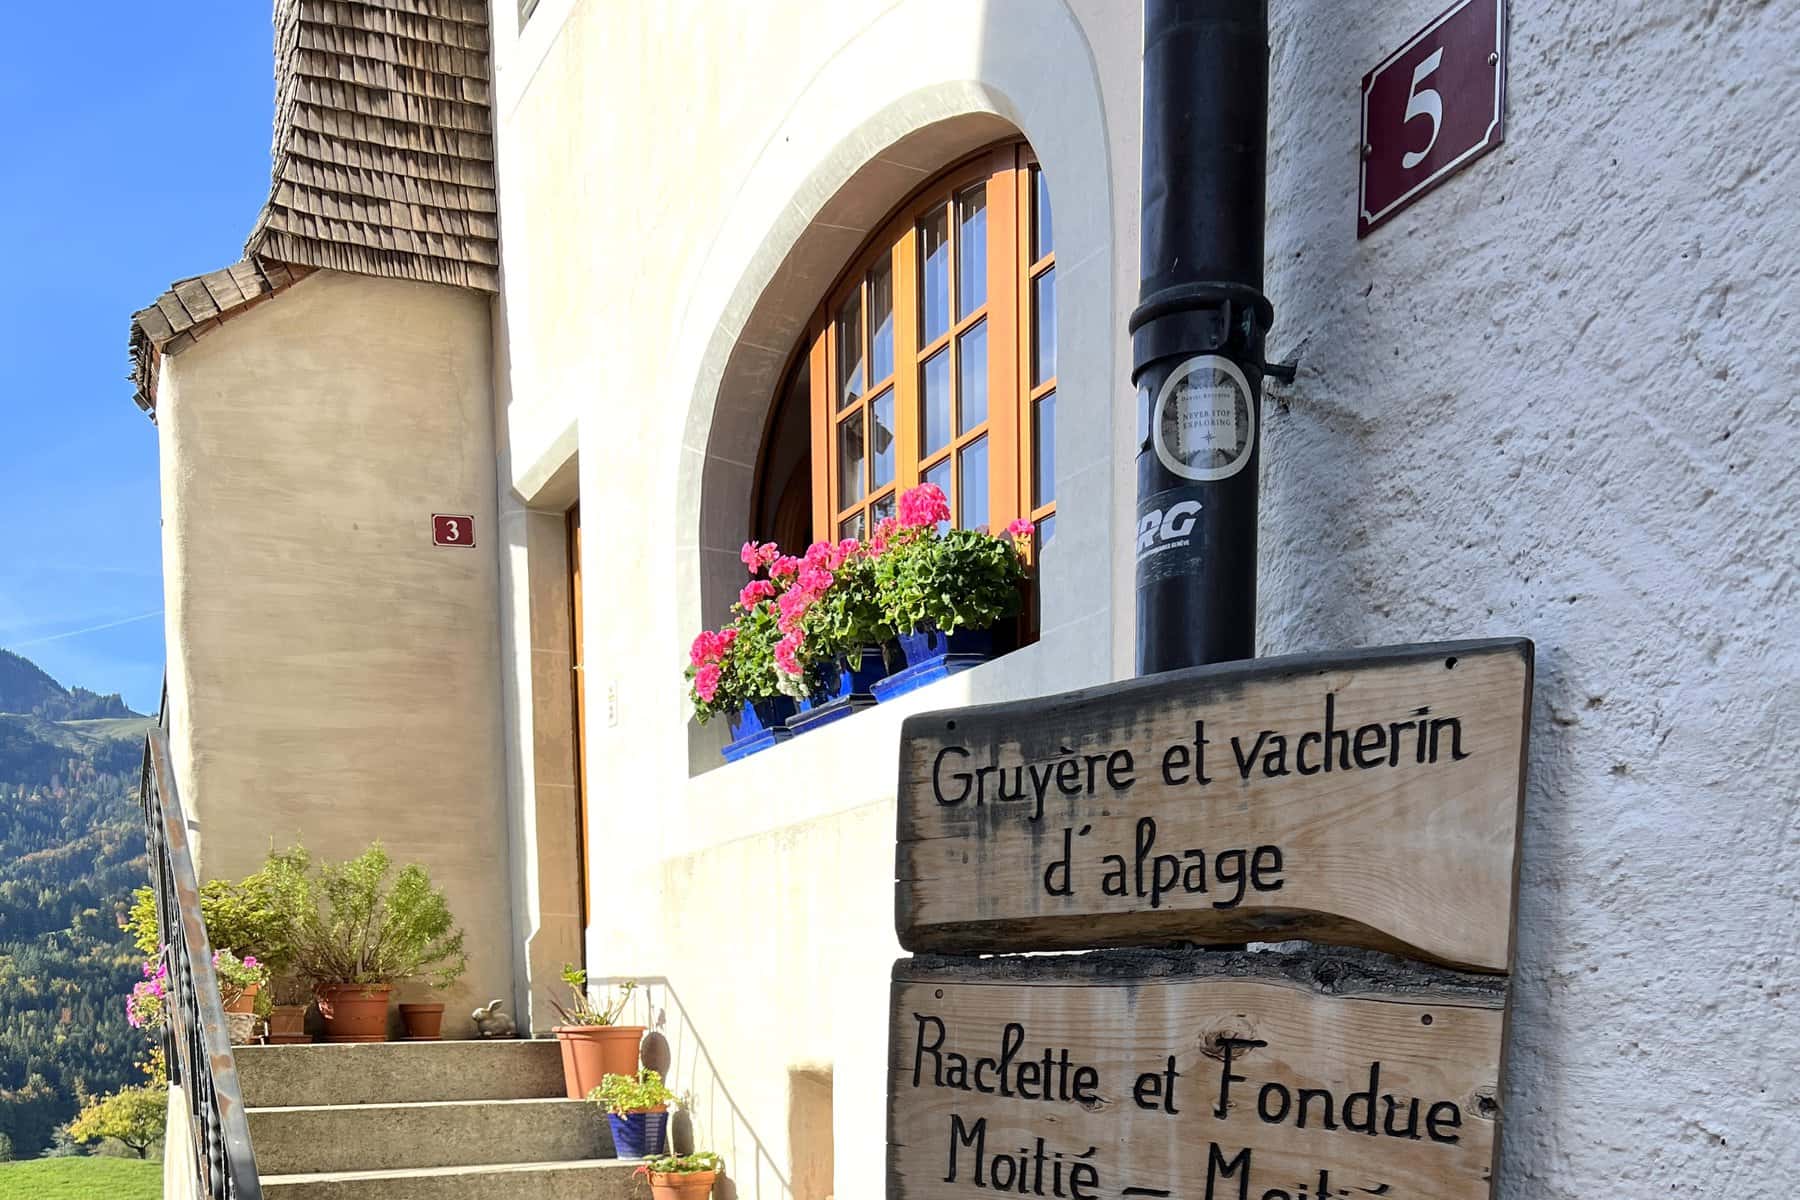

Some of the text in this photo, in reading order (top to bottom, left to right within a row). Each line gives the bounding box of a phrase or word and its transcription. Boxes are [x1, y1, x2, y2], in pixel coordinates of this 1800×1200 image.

[1402, 46, 1443, 169] 5
[446, 520, 459, 541] 3
[1136, 500, 1203, 555] RG
[932, 692, 1470, 824] Gruyère et vacherin
[912, 1012, 1463, 1145] Raclette et Fondue
